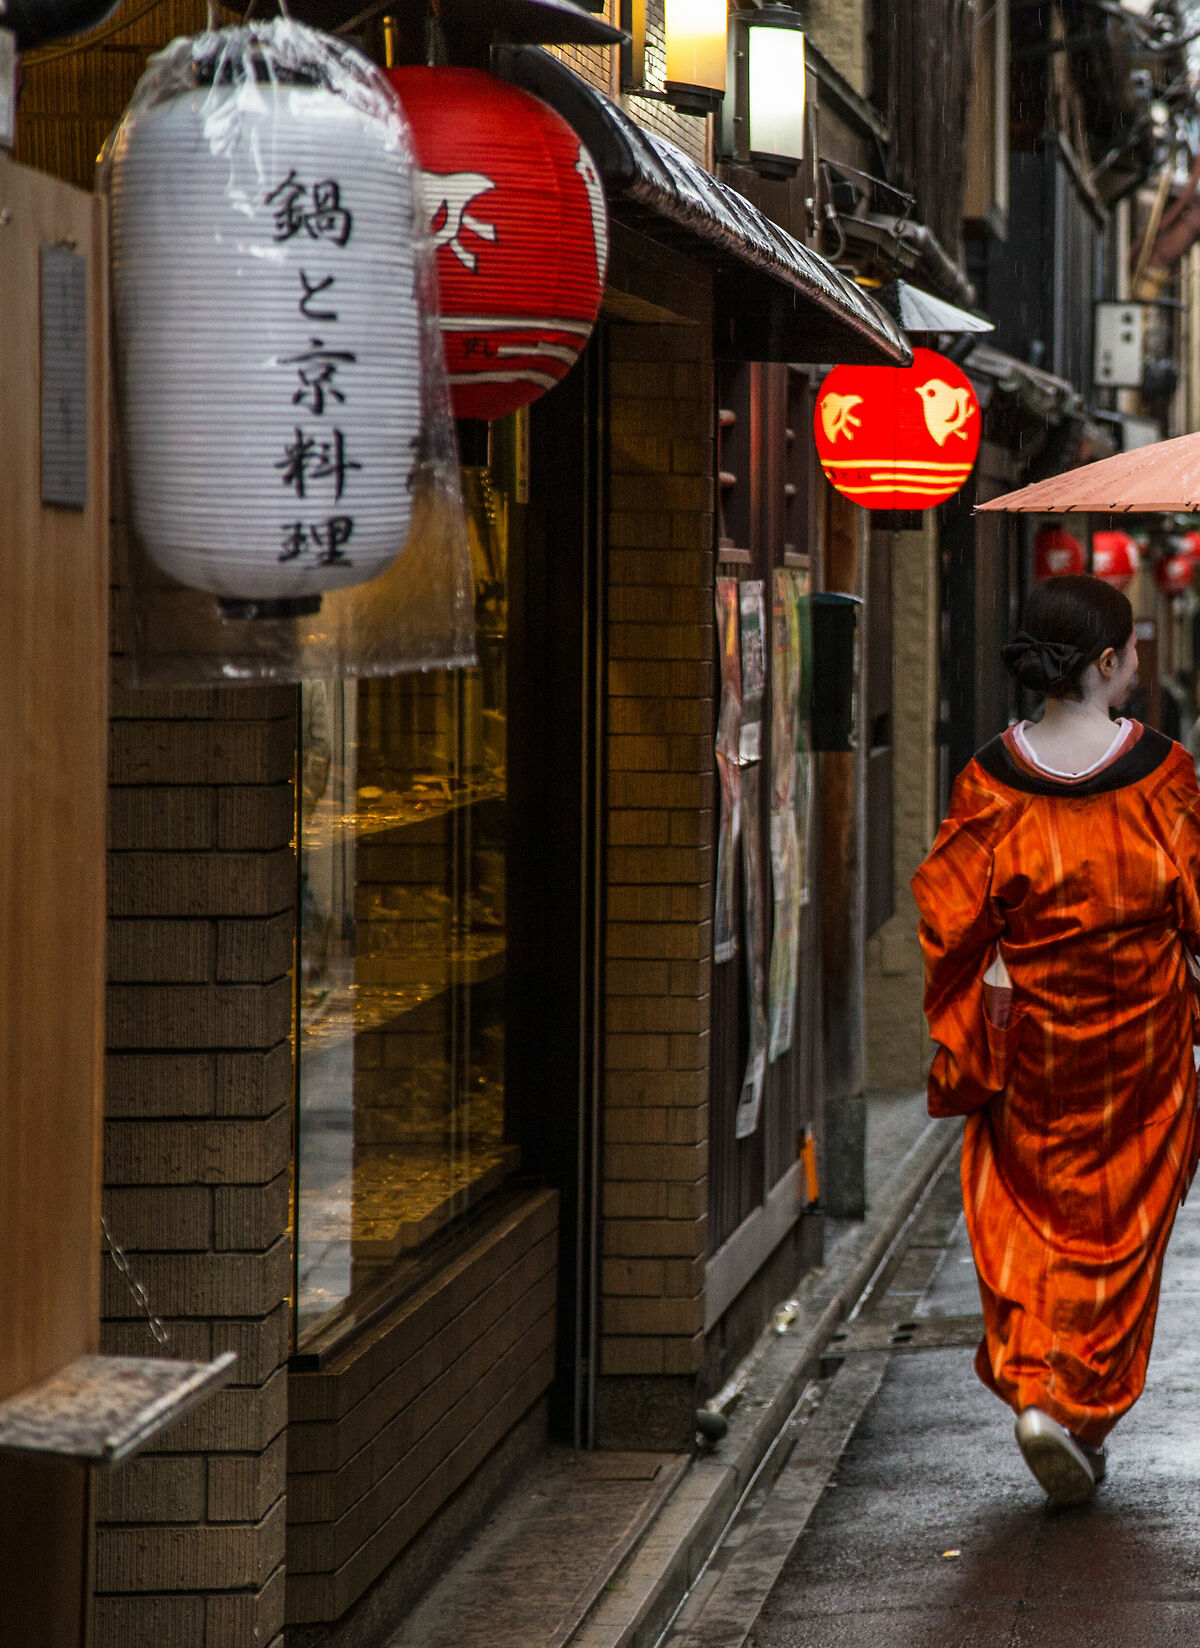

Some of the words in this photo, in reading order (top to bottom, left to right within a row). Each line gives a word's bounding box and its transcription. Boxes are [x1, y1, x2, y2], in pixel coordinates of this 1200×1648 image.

[264, 168, 362, 570] 鍋と京料理
